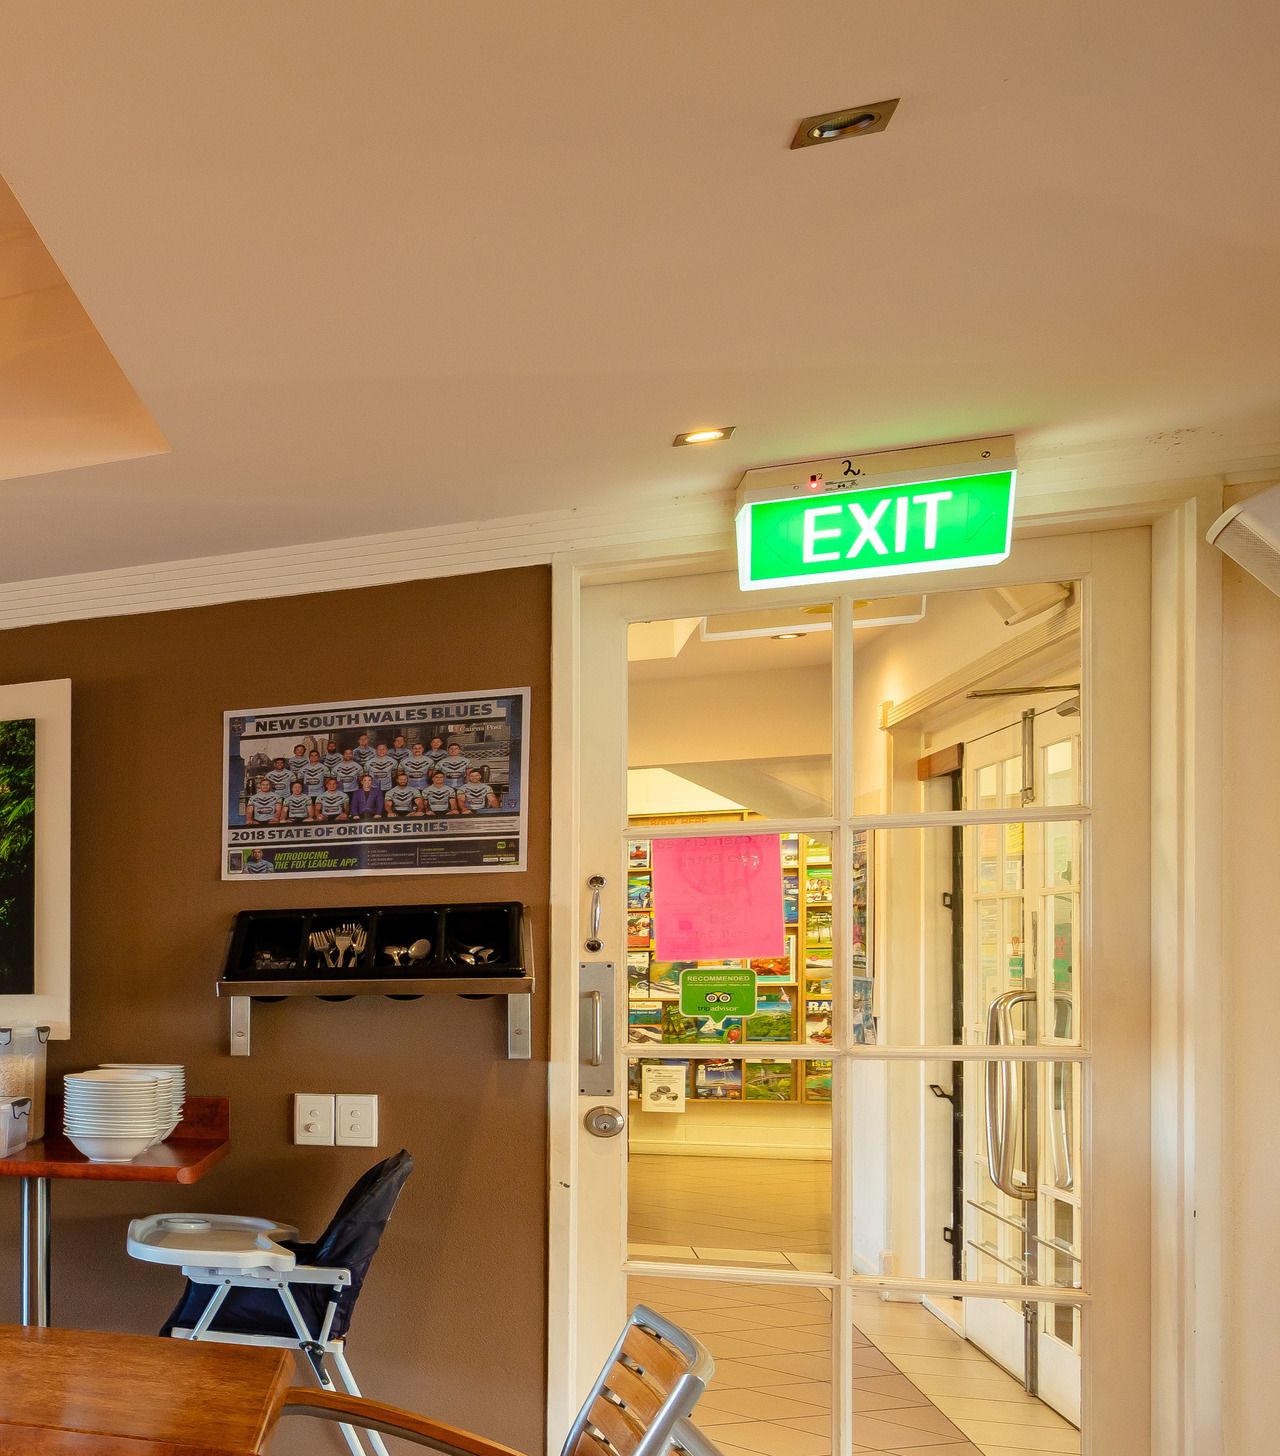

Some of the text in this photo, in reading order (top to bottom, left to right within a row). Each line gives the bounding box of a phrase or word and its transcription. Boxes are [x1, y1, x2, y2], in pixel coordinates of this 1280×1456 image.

[802, 491, 953, 564] EXIT
[256, 719, 296, 732] NEW
[299, 714, 359, 729] SOUTH
[363, 709, 428, 723] WALES
[431, 704, 492, 719] BLUES
[232, 830, 265, 841] 2018
[268, 828, 311, 839] STATE
[314, 827, 334, 837] OF
[337, 824, 390, 836] ORIGIN
[393, 822, 448, 833] SERIES
[274, 851, 329, 860] INTRODUCING
[274, 861, 289, 869] THE
[291, 860, 307, 868] FOX
[308, 859, 338, 868] LEAGUE
